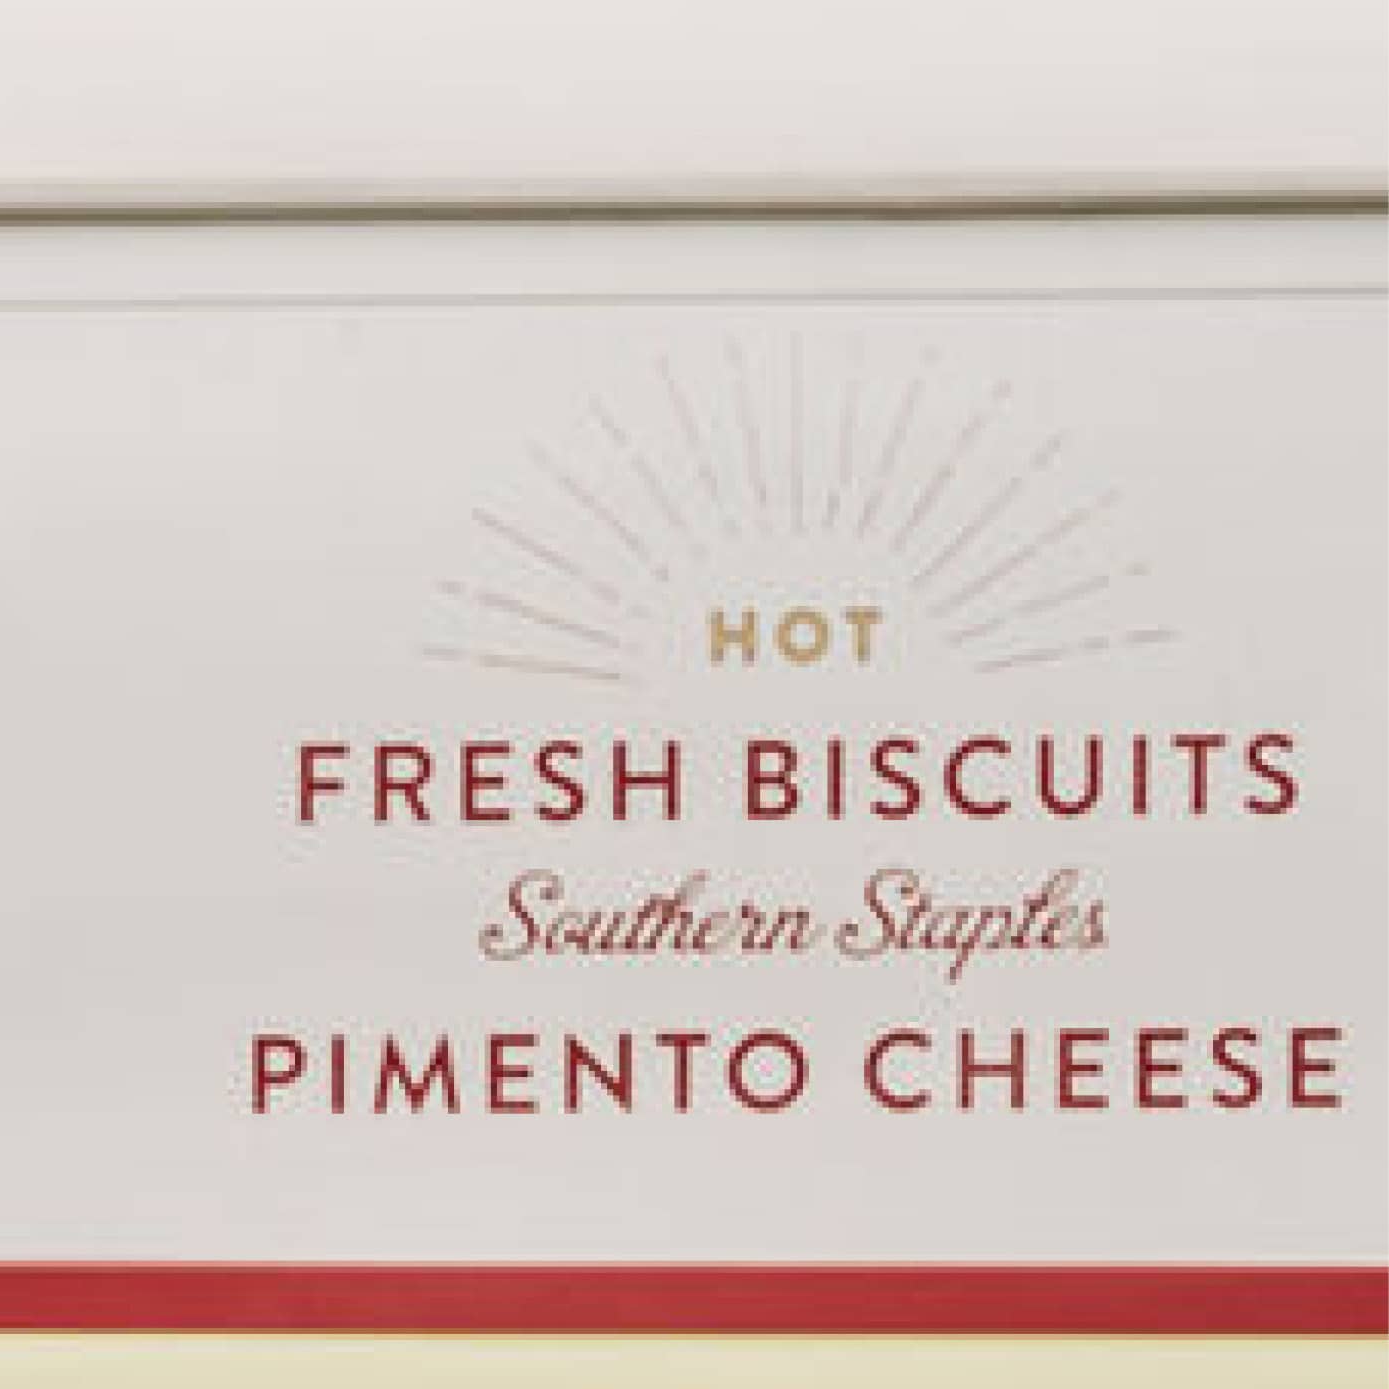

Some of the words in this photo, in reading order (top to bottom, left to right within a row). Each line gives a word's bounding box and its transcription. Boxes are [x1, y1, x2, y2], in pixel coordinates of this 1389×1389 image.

[709, 605, 880, 664] HOT
[297, 739, 684, 822] FRESH
[745, 733, 1300, 822] BISCUITS
[478, 868, 822, 961] Southern
[835, 866, 1108, 984] Staples
[251, 1029, 810, 1115] PIMENTO
[862, 1025, 1343, 1115] CHEESE
